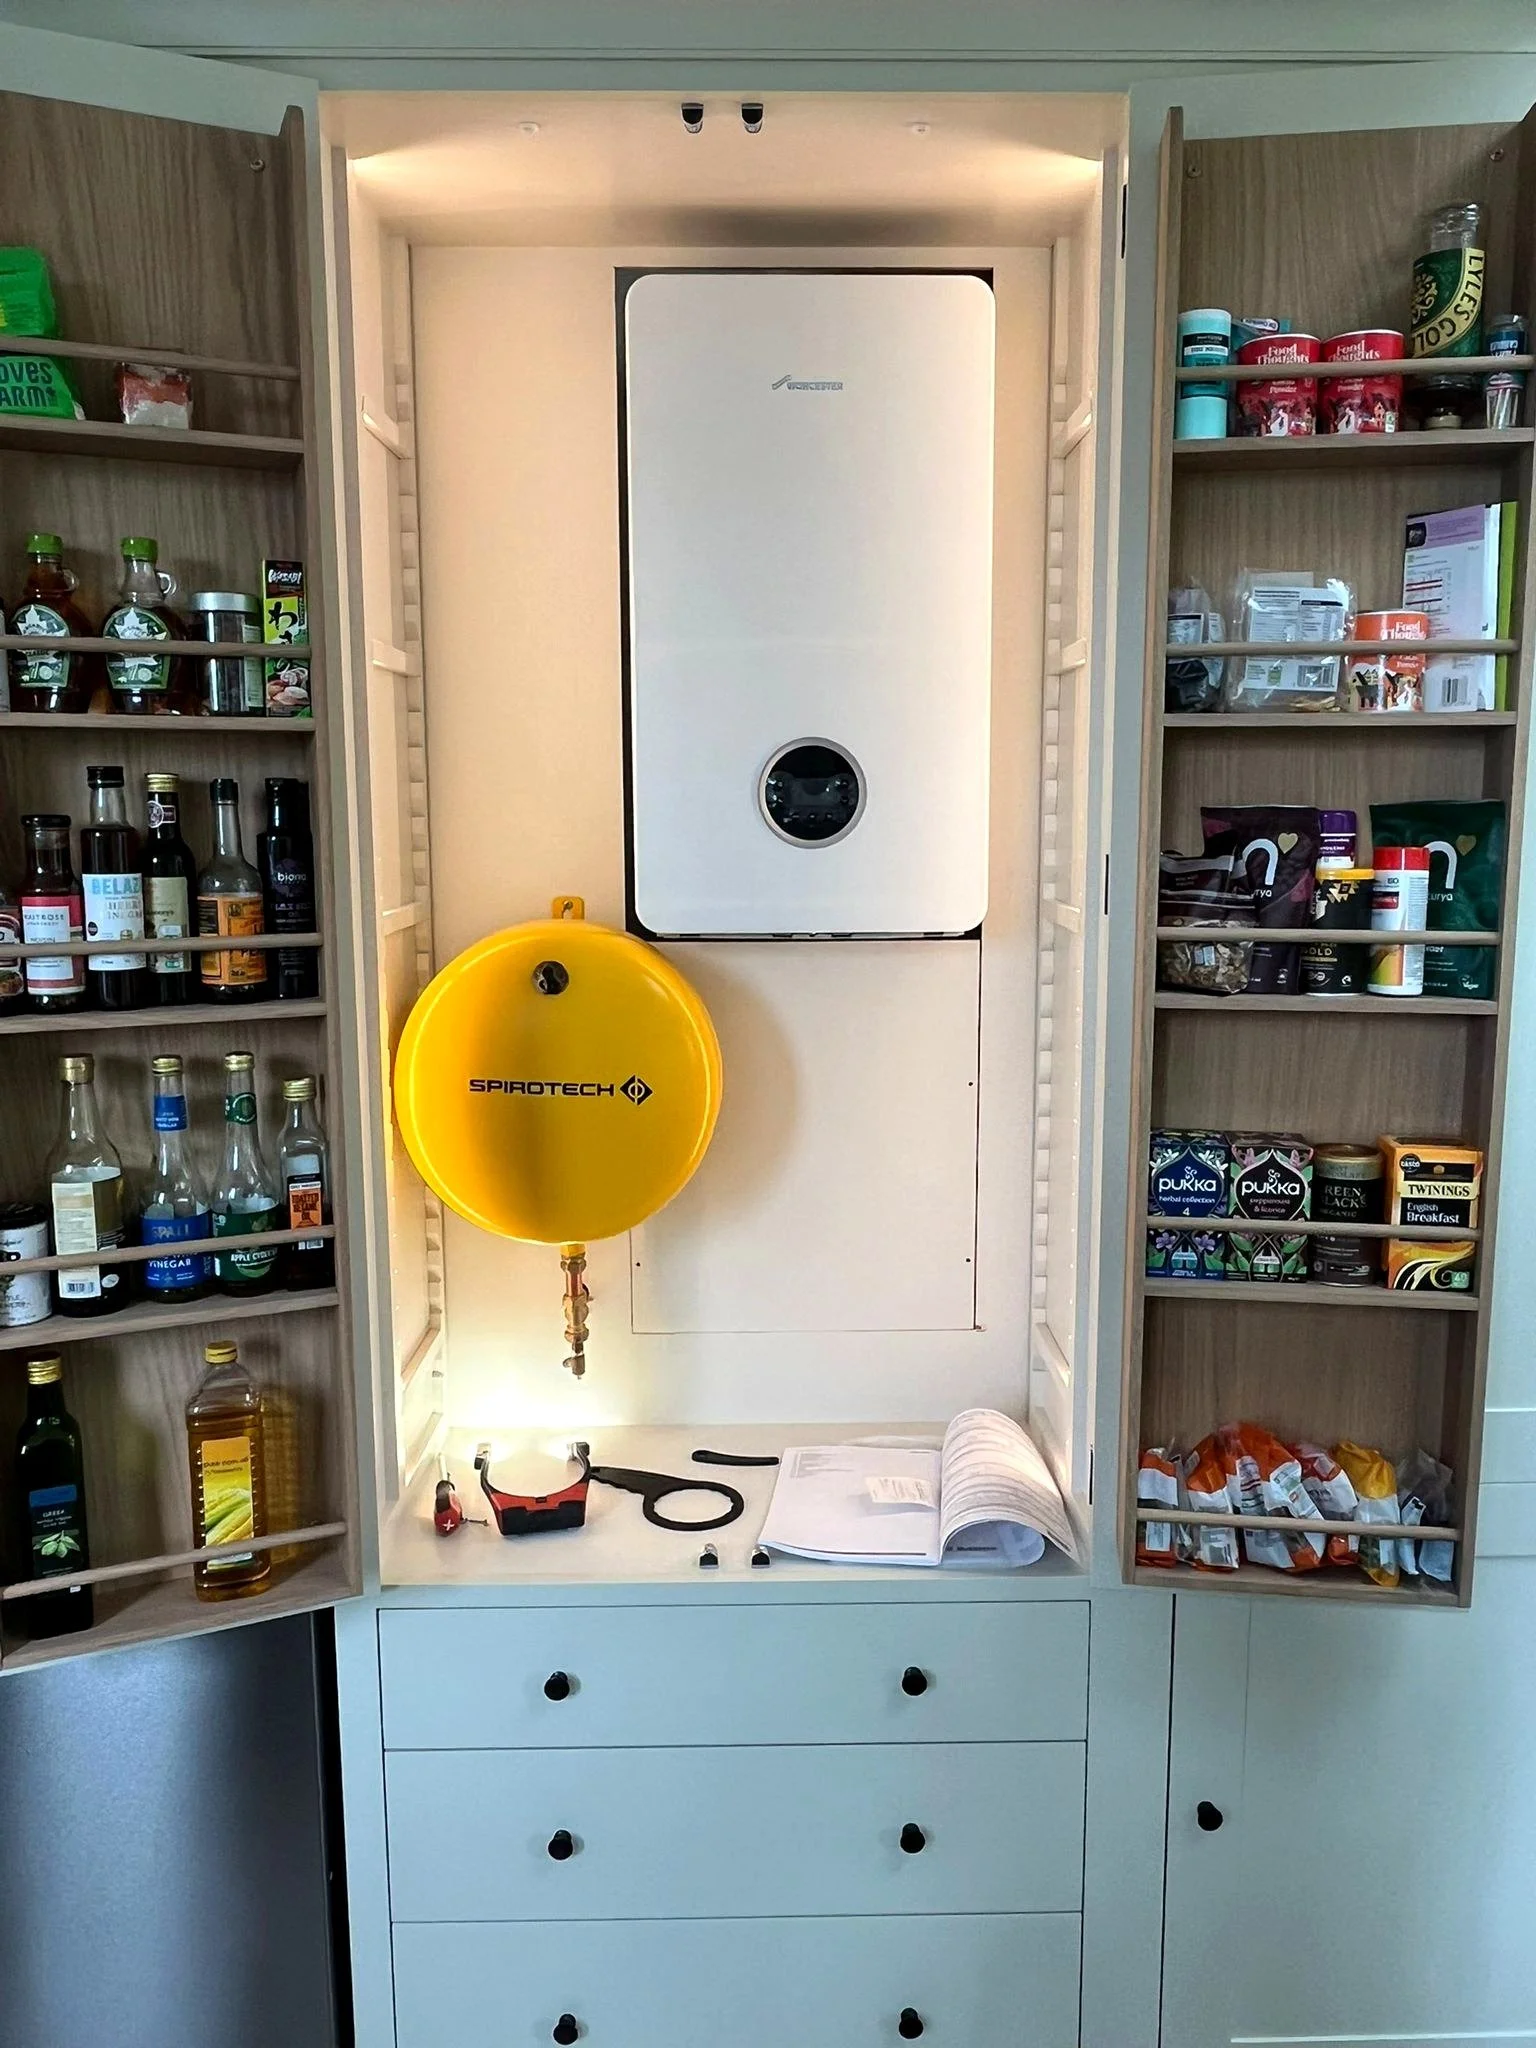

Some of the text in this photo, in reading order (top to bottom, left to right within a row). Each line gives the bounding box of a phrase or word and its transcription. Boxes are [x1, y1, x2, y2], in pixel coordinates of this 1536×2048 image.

[469, 1078, 615, 1098] SPIROTECH
[1159, 1171, 1217, 1193] pukka
[1242, 1174, 1301, 1197] pukka
[1407, 1183, 1470, 1198] TWININGS
[1182, 1196, 1216, 1204] collection
[1182, 1207, 1190, 1216] 4
[1406, 1202, 1439, 1213] English
[1406, 1212, 1460, 1224] Breakfast
[148, 1258, 192, 1269] VINEGAR
